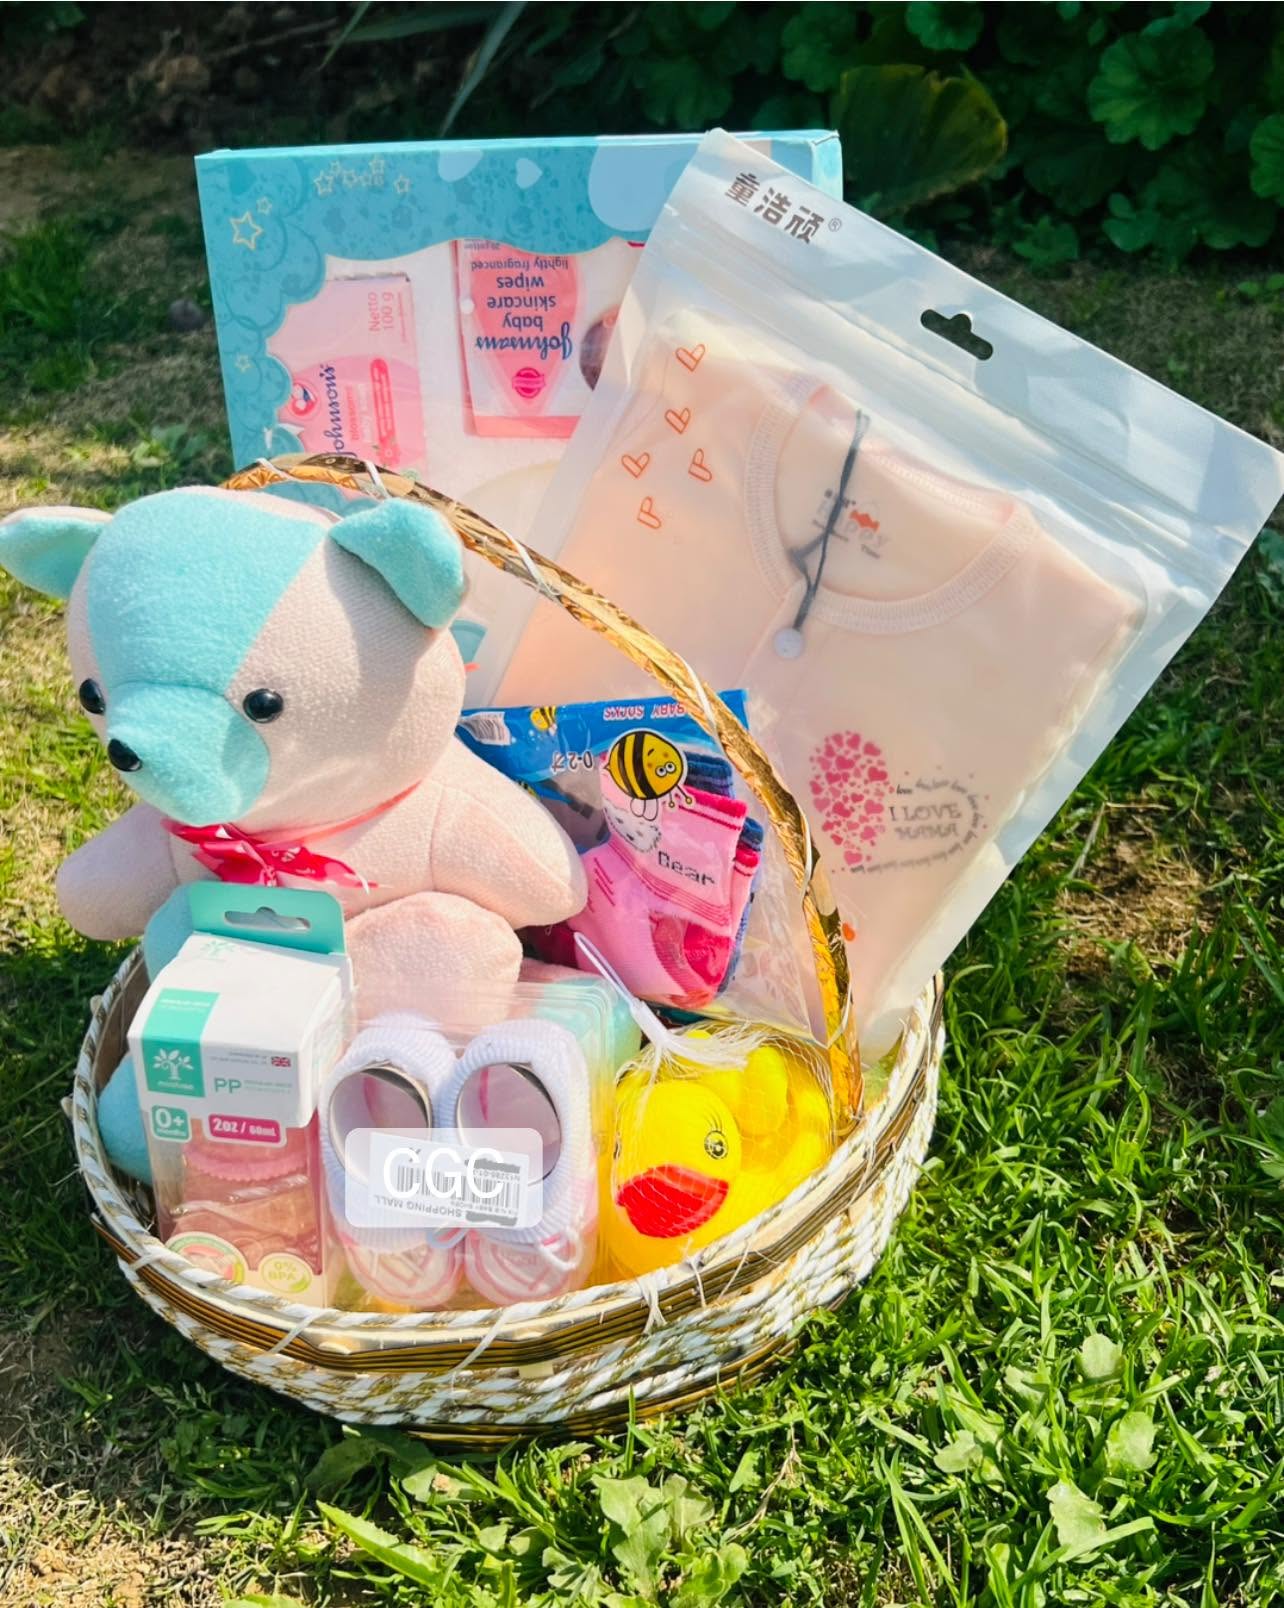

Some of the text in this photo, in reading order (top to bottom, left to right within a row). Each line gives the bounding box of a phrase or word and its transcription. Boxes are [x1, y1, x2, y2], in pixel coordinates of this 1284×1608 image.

[470, 256, 569, 272] lightly fragranced
[496, 275, 545, 292] wipes
[368, 291, 382, 333] Netto
[486, 295, 557, 312] skincare
[381, 305, 394, 331] 100
[501, 313, 544, 332] baby
[604, 702, 685, 720] BABY SOCKS
[888, 802, 962, 822] I LOVE
[657, 851, 716, 886] Bear
[213, 1077, 242, 1094] PP
[373, 1194, 463, 1219] SHOPPING MALL
